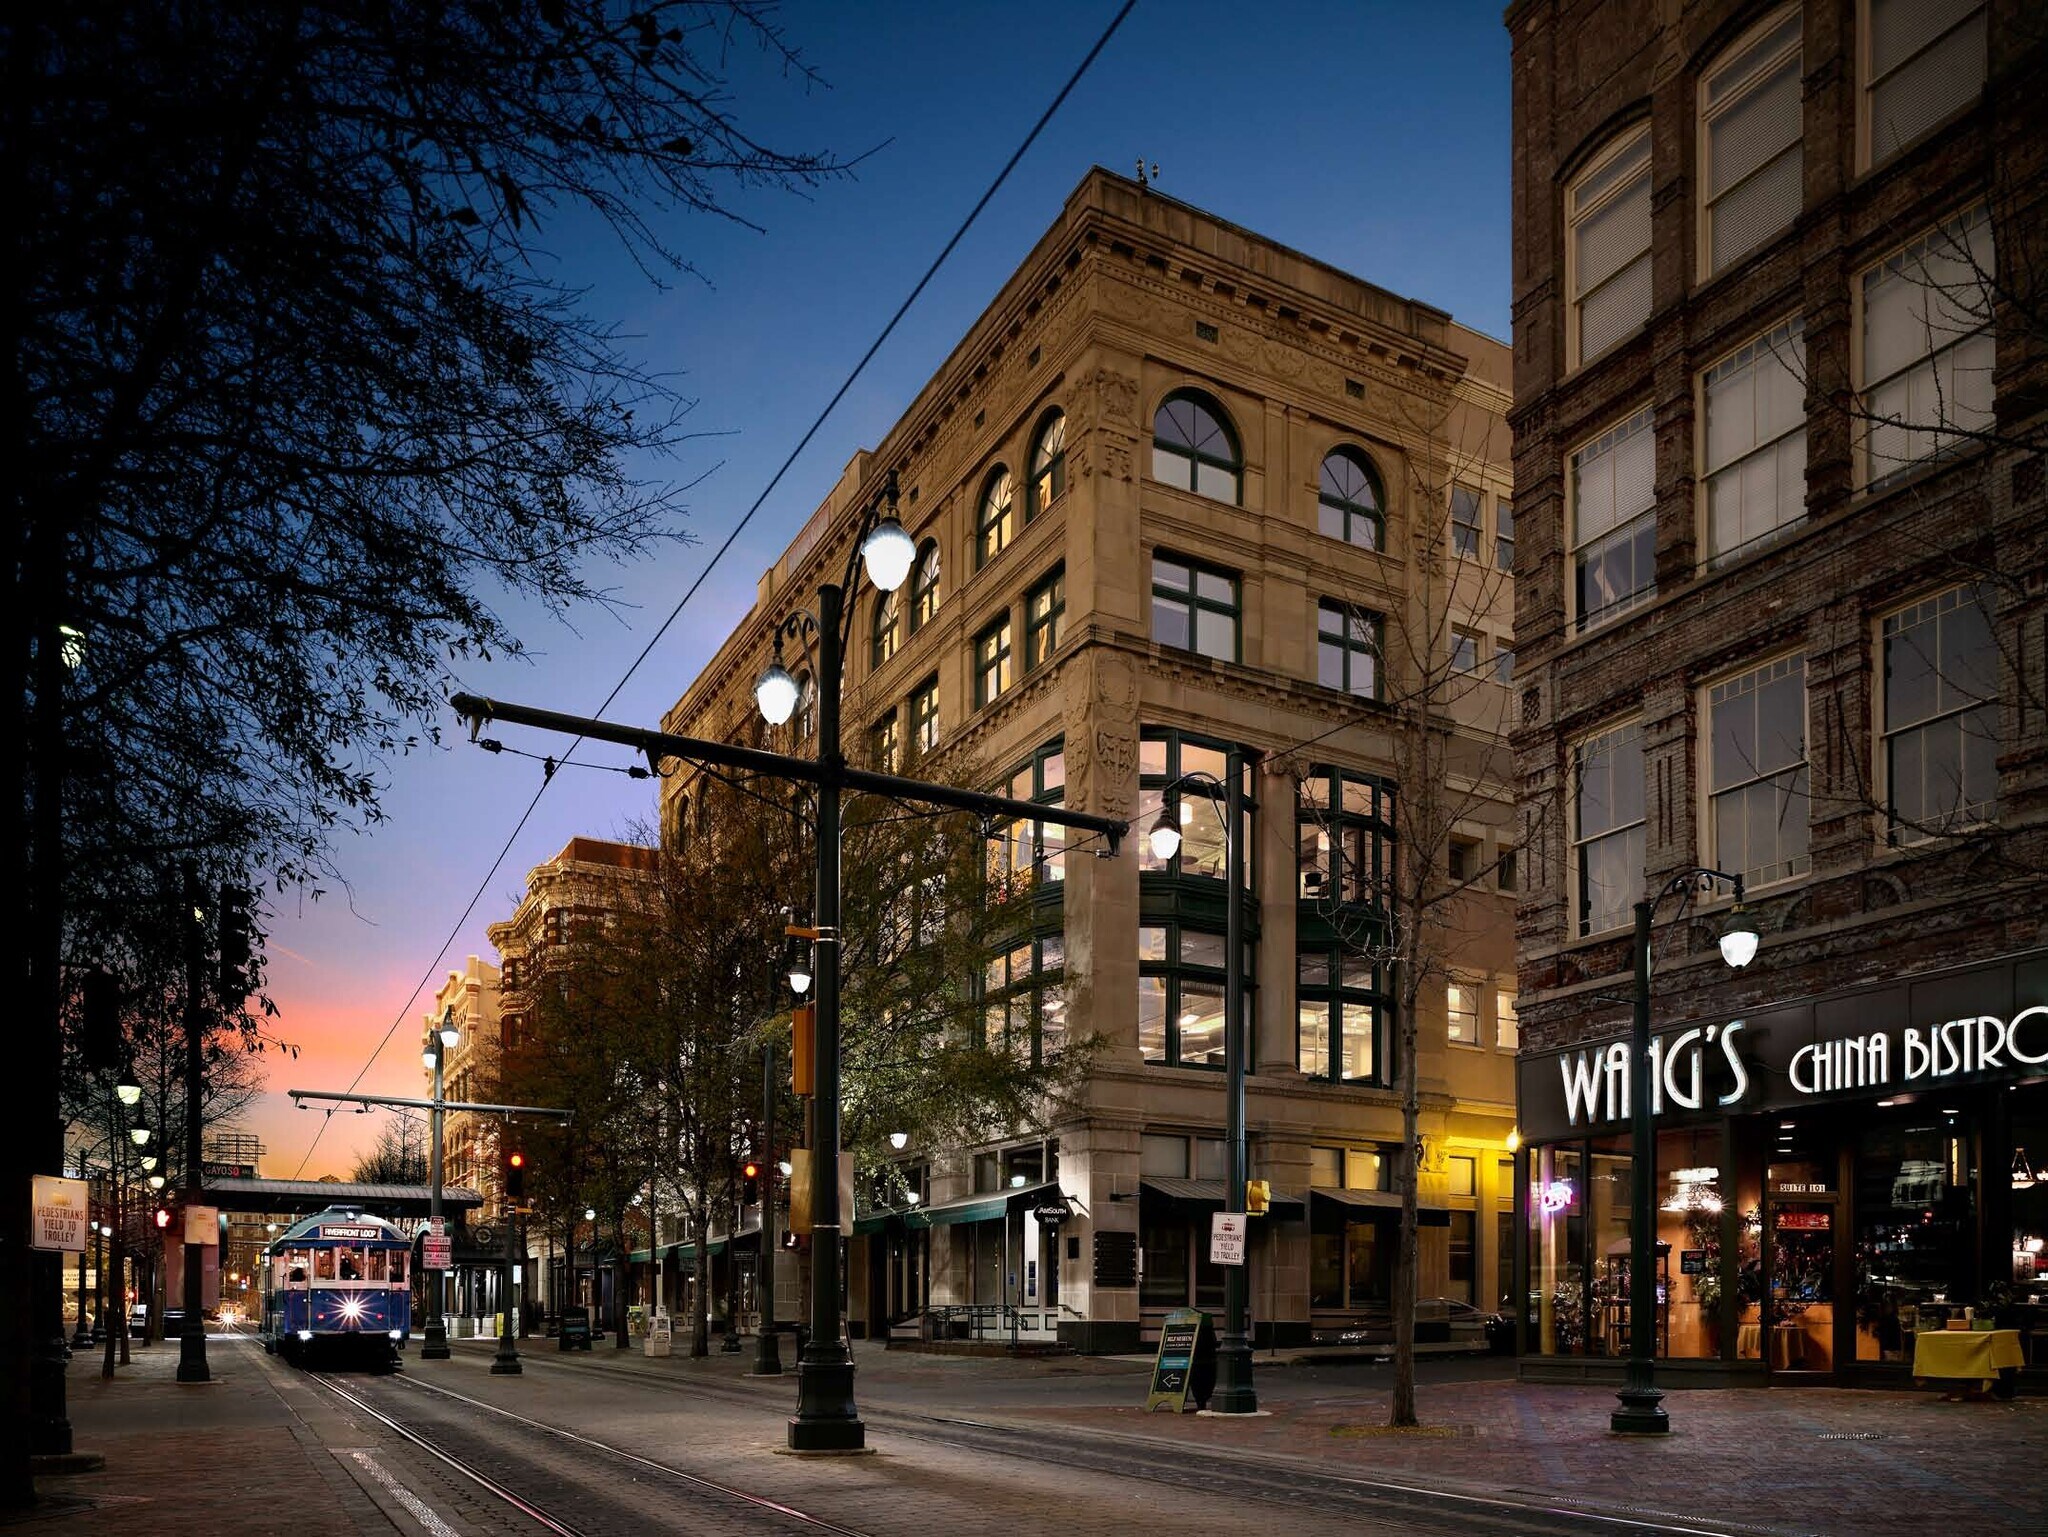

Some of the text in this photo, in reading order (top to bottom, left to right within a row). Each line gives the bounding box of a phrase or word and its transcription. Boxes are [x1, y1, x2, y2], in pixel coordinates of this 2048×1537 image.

[1788, 1032, 1892, 1094] CHINA
[1903, 1005, 2048, 1081] BISTRO
[205, 1165, 239, 1176] GAYOSO
[1780, 1183, 1806, 1192] SUITE
[37, 1206, 84, 1221] PEDESTRIANS
[44, 1219, 77, 1232] YIELD TO
[44, 1230, 75, 1243] TROLLEY
[324, 1228, 377, 1238] RIVERFRONT LOOP
